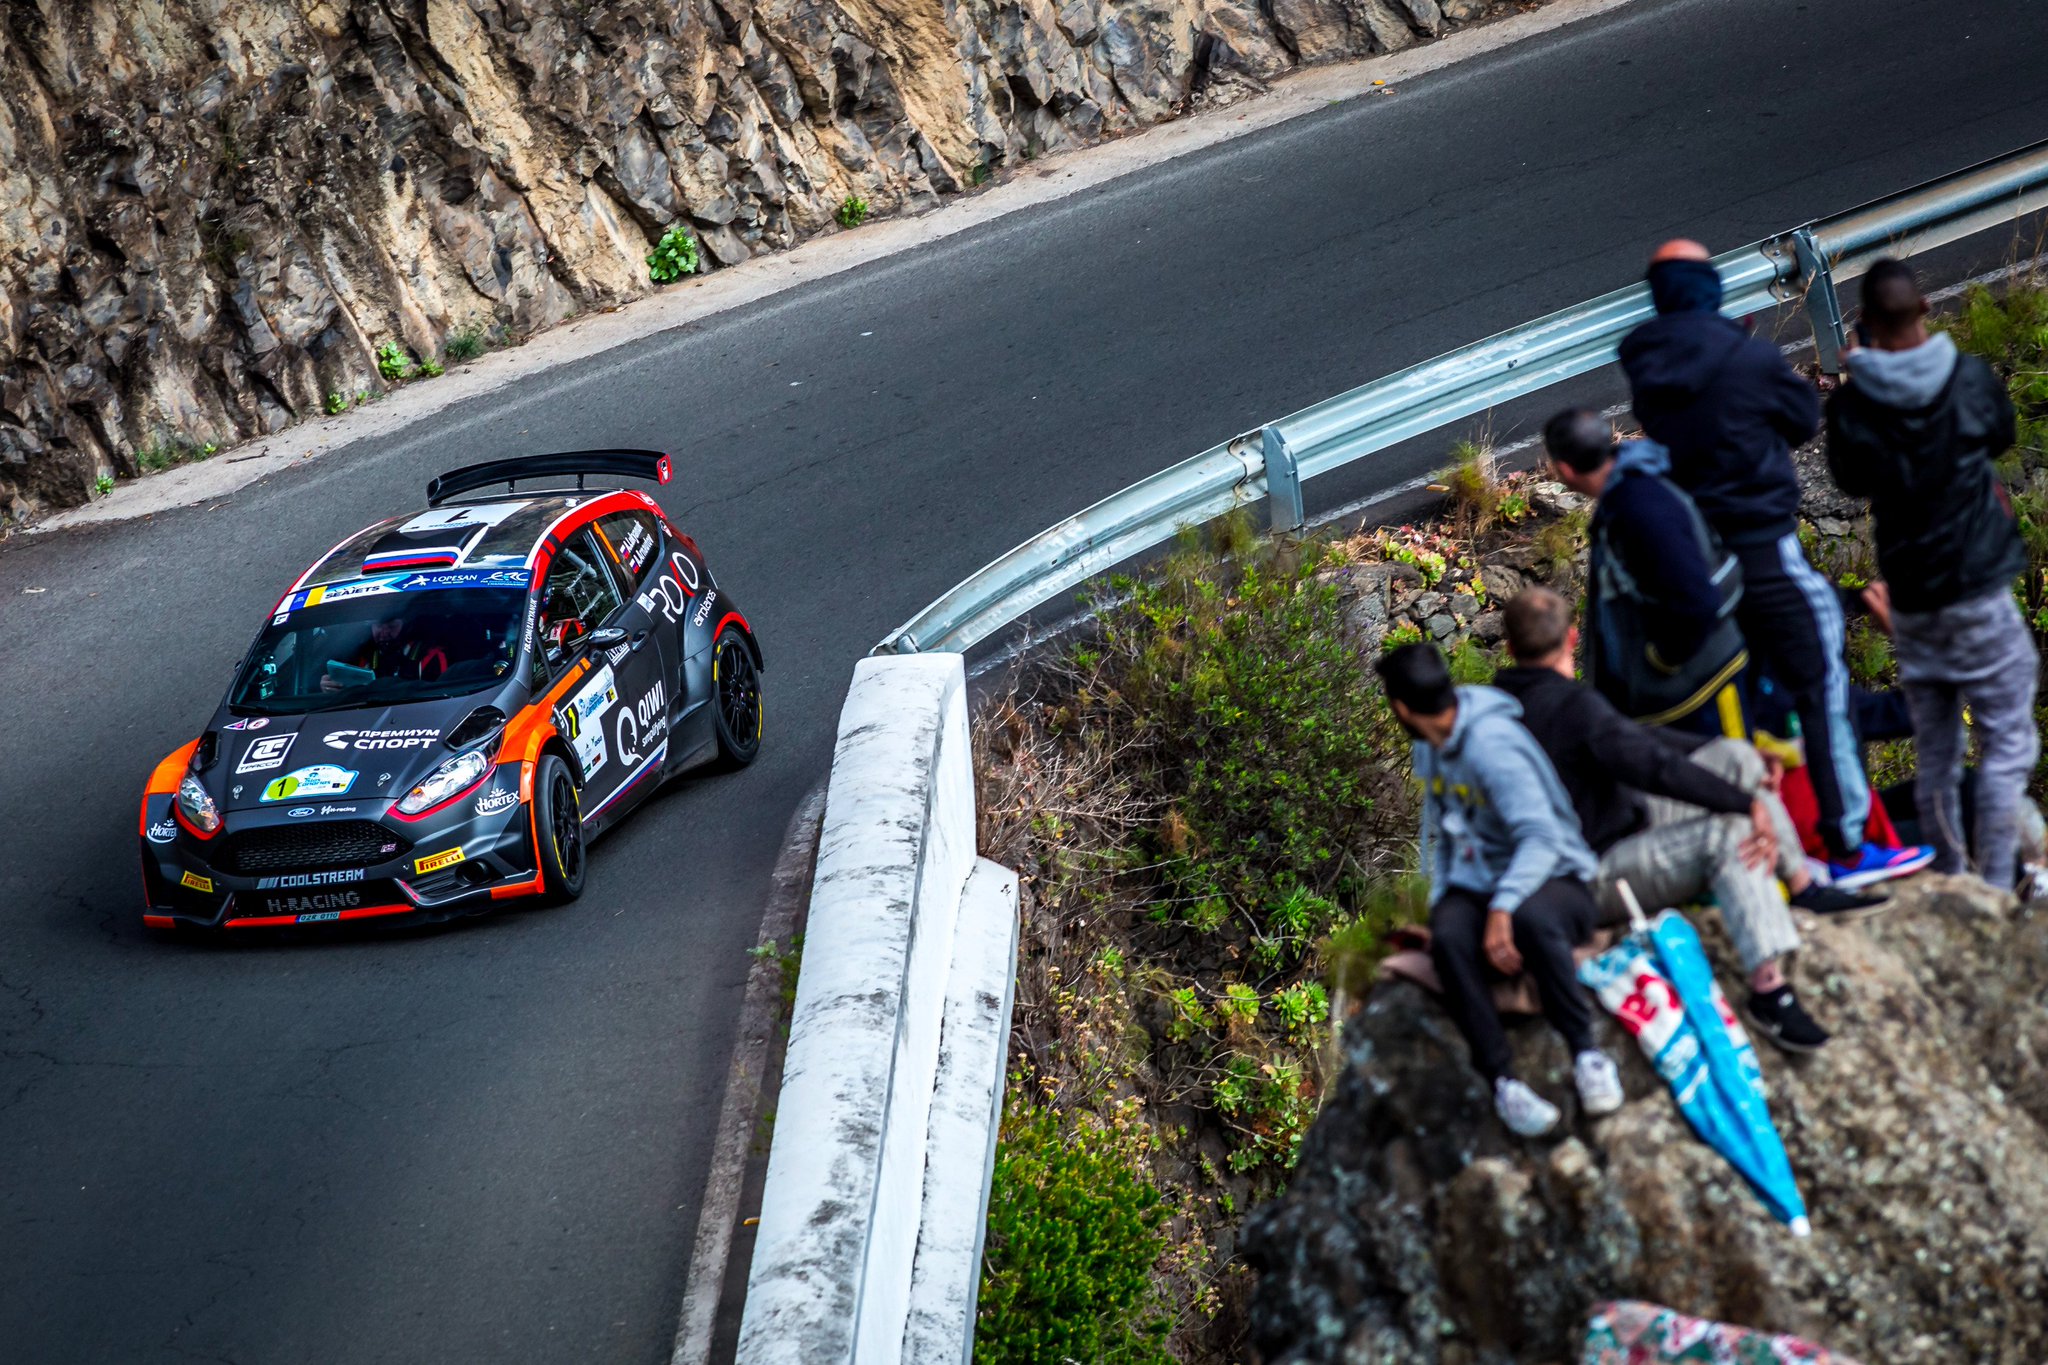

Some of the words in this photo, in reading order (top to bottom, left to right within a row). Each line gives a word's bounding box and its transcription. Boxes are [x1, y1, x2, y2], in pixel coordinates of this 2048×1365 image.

[432, 575, 477, 583] LOPESAN
[325, 586, 380, 599] SEAJETS
[638, 680, 665, 728] QIWI
[567, 707, 577, 738] 1
[359, 729, 440, 738] ПРЕМИУМ
[354, 738, 437, 749] СПОРТ
[277, 779, 287, 796] 1
[477, 790, 520, 812] HORTEX
[419, 850, 461, 871] PIRELLI
[281, 869, 365, 888] COOLSTREAM
[267, 891, 360, 913] H-RACING
